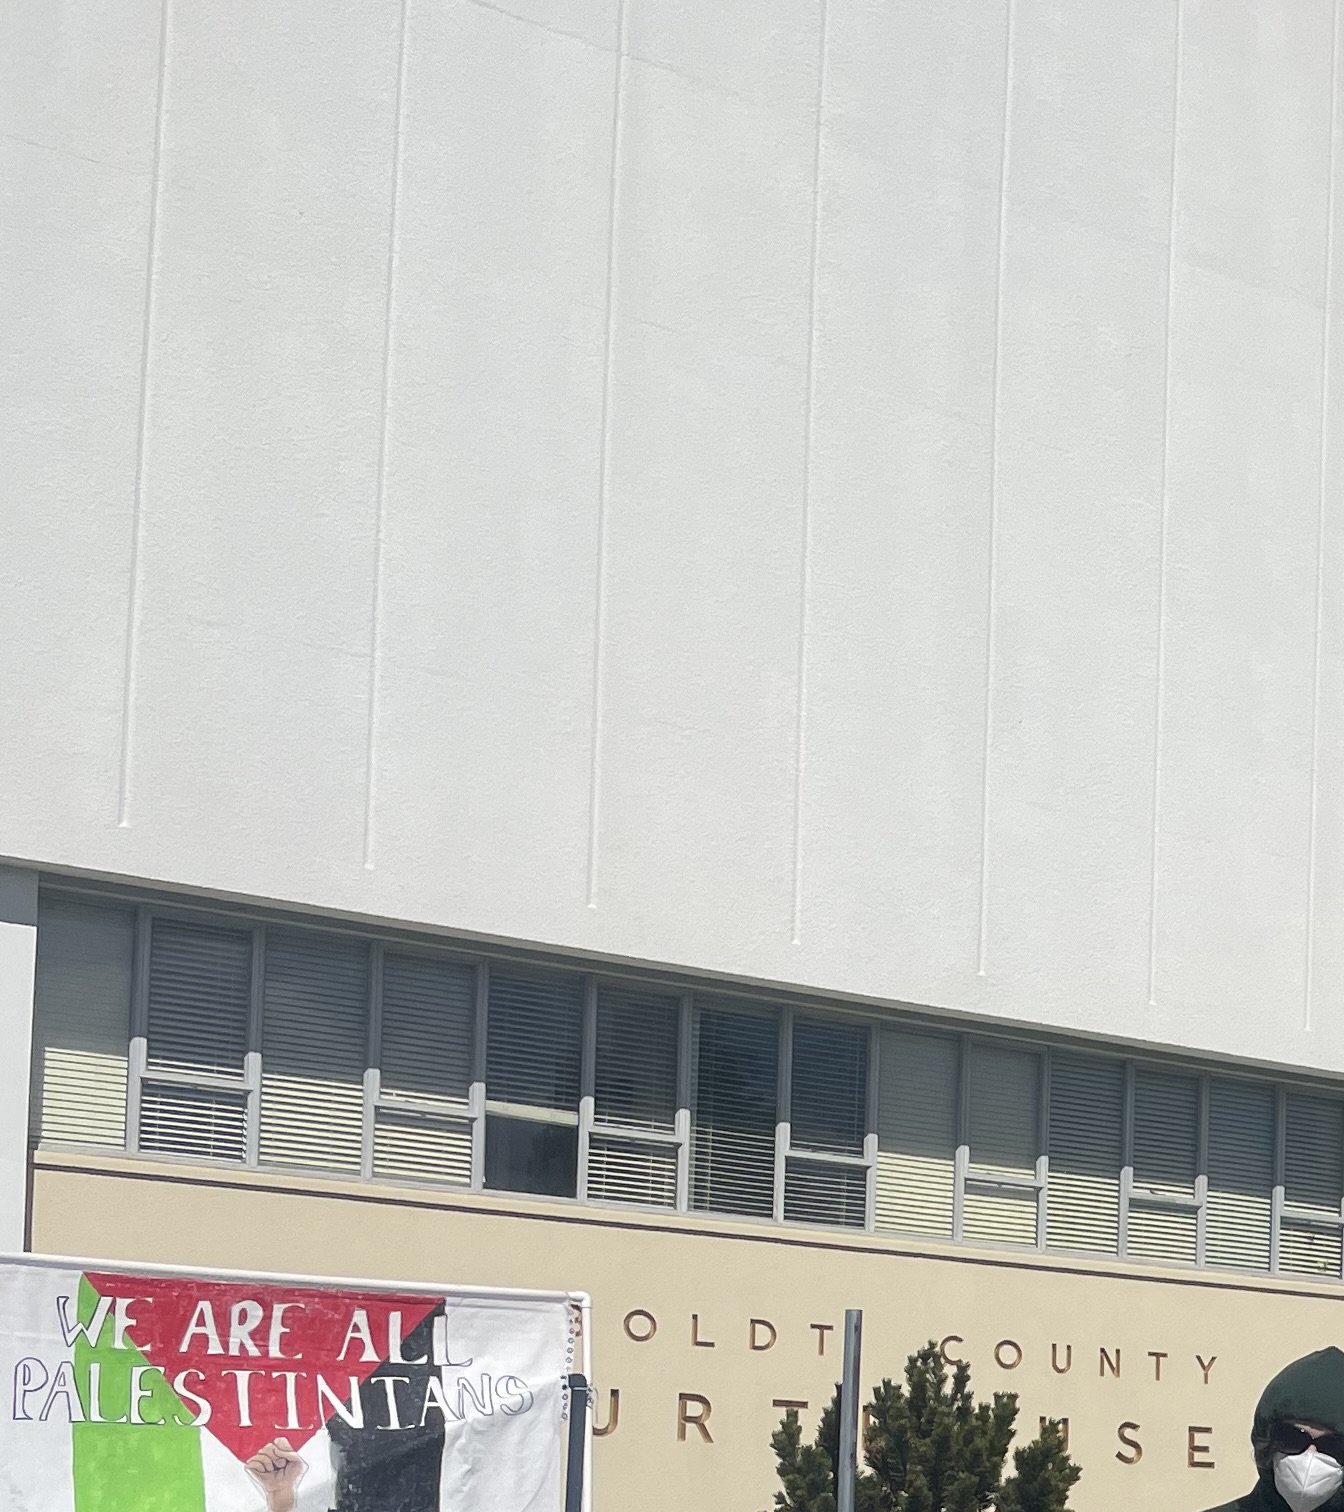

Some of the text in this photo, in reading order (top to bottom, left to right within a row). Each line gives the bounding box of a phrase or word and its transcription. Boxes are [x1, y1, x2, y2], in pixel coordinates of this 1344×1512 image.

[57, 1295, 474, 1368] WE ARE ALL
[940, 1335, 1218, 1385] COUNTY
[12, 1356, 535, 1431] PALESTINIANS
